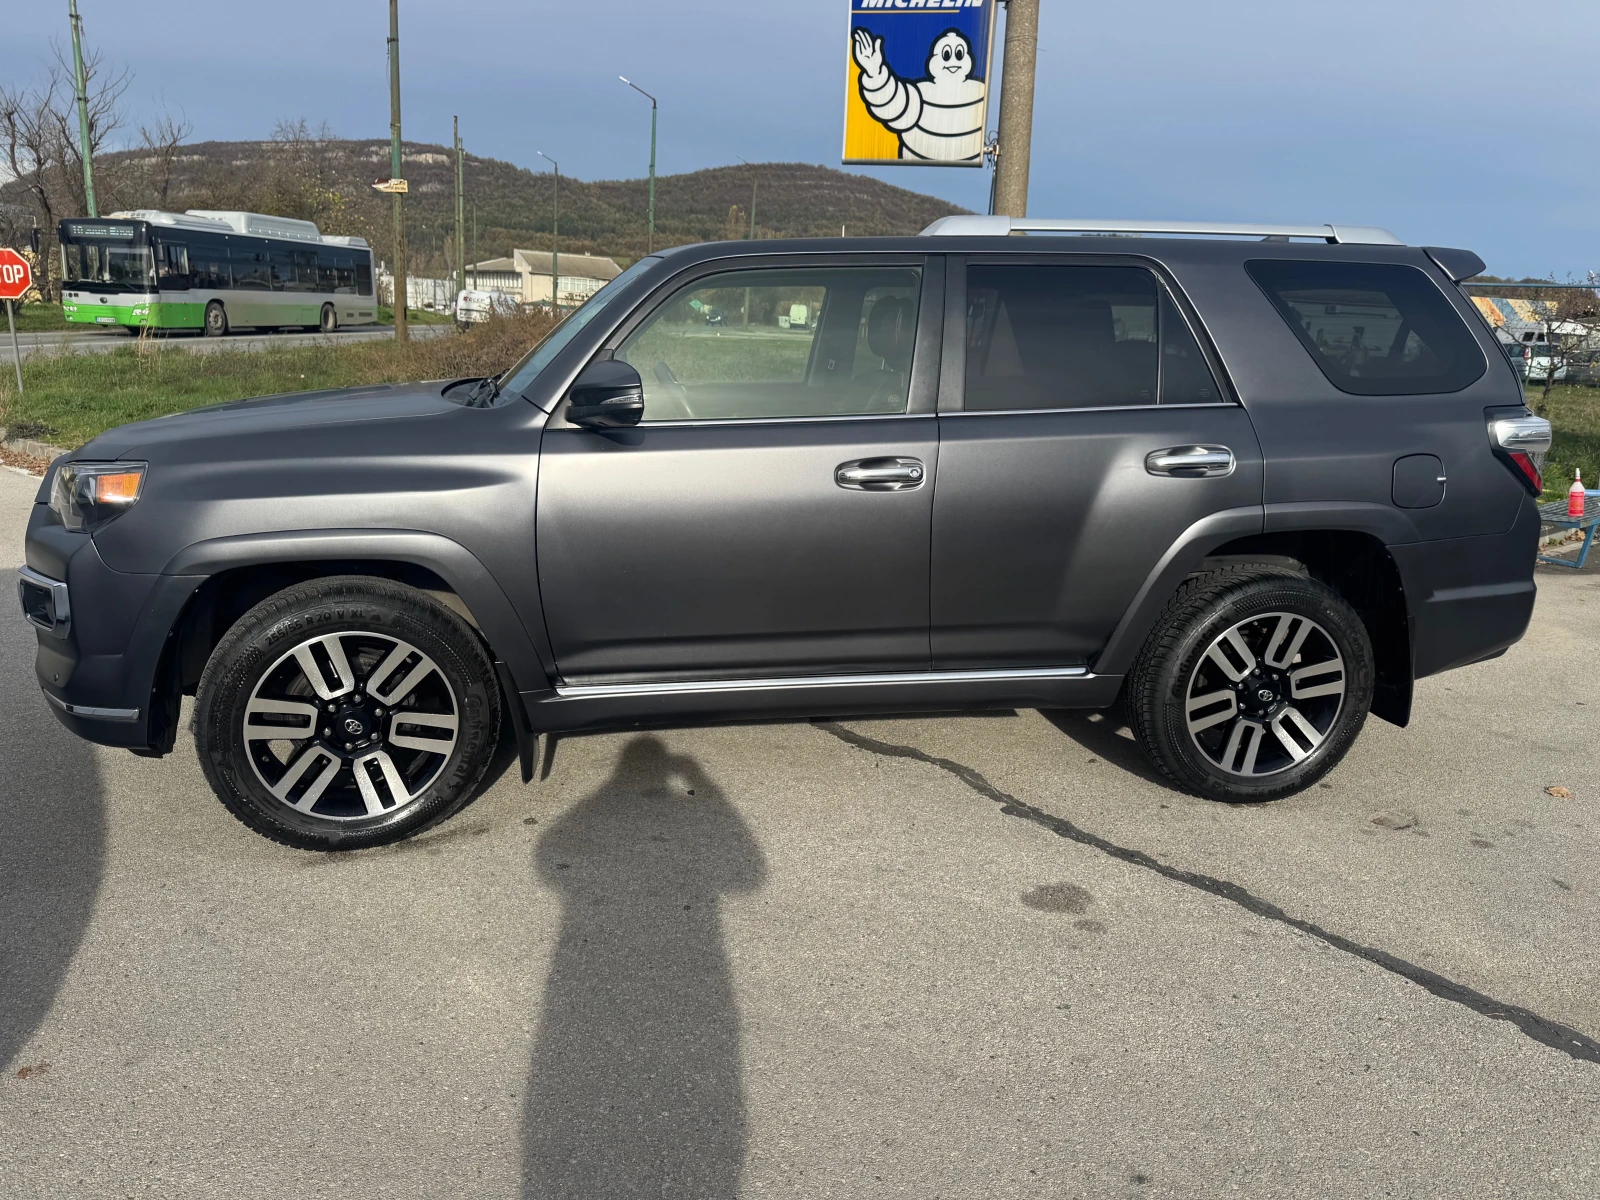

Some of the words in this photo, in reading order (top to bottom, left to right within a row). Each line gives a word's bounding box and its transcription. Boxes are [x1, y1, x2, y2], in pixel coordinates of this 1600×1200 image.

[0, 264, 24, 284] OP
[264, 619, 303, 647] 255/55
[453, 693, 484, 779] Continental
